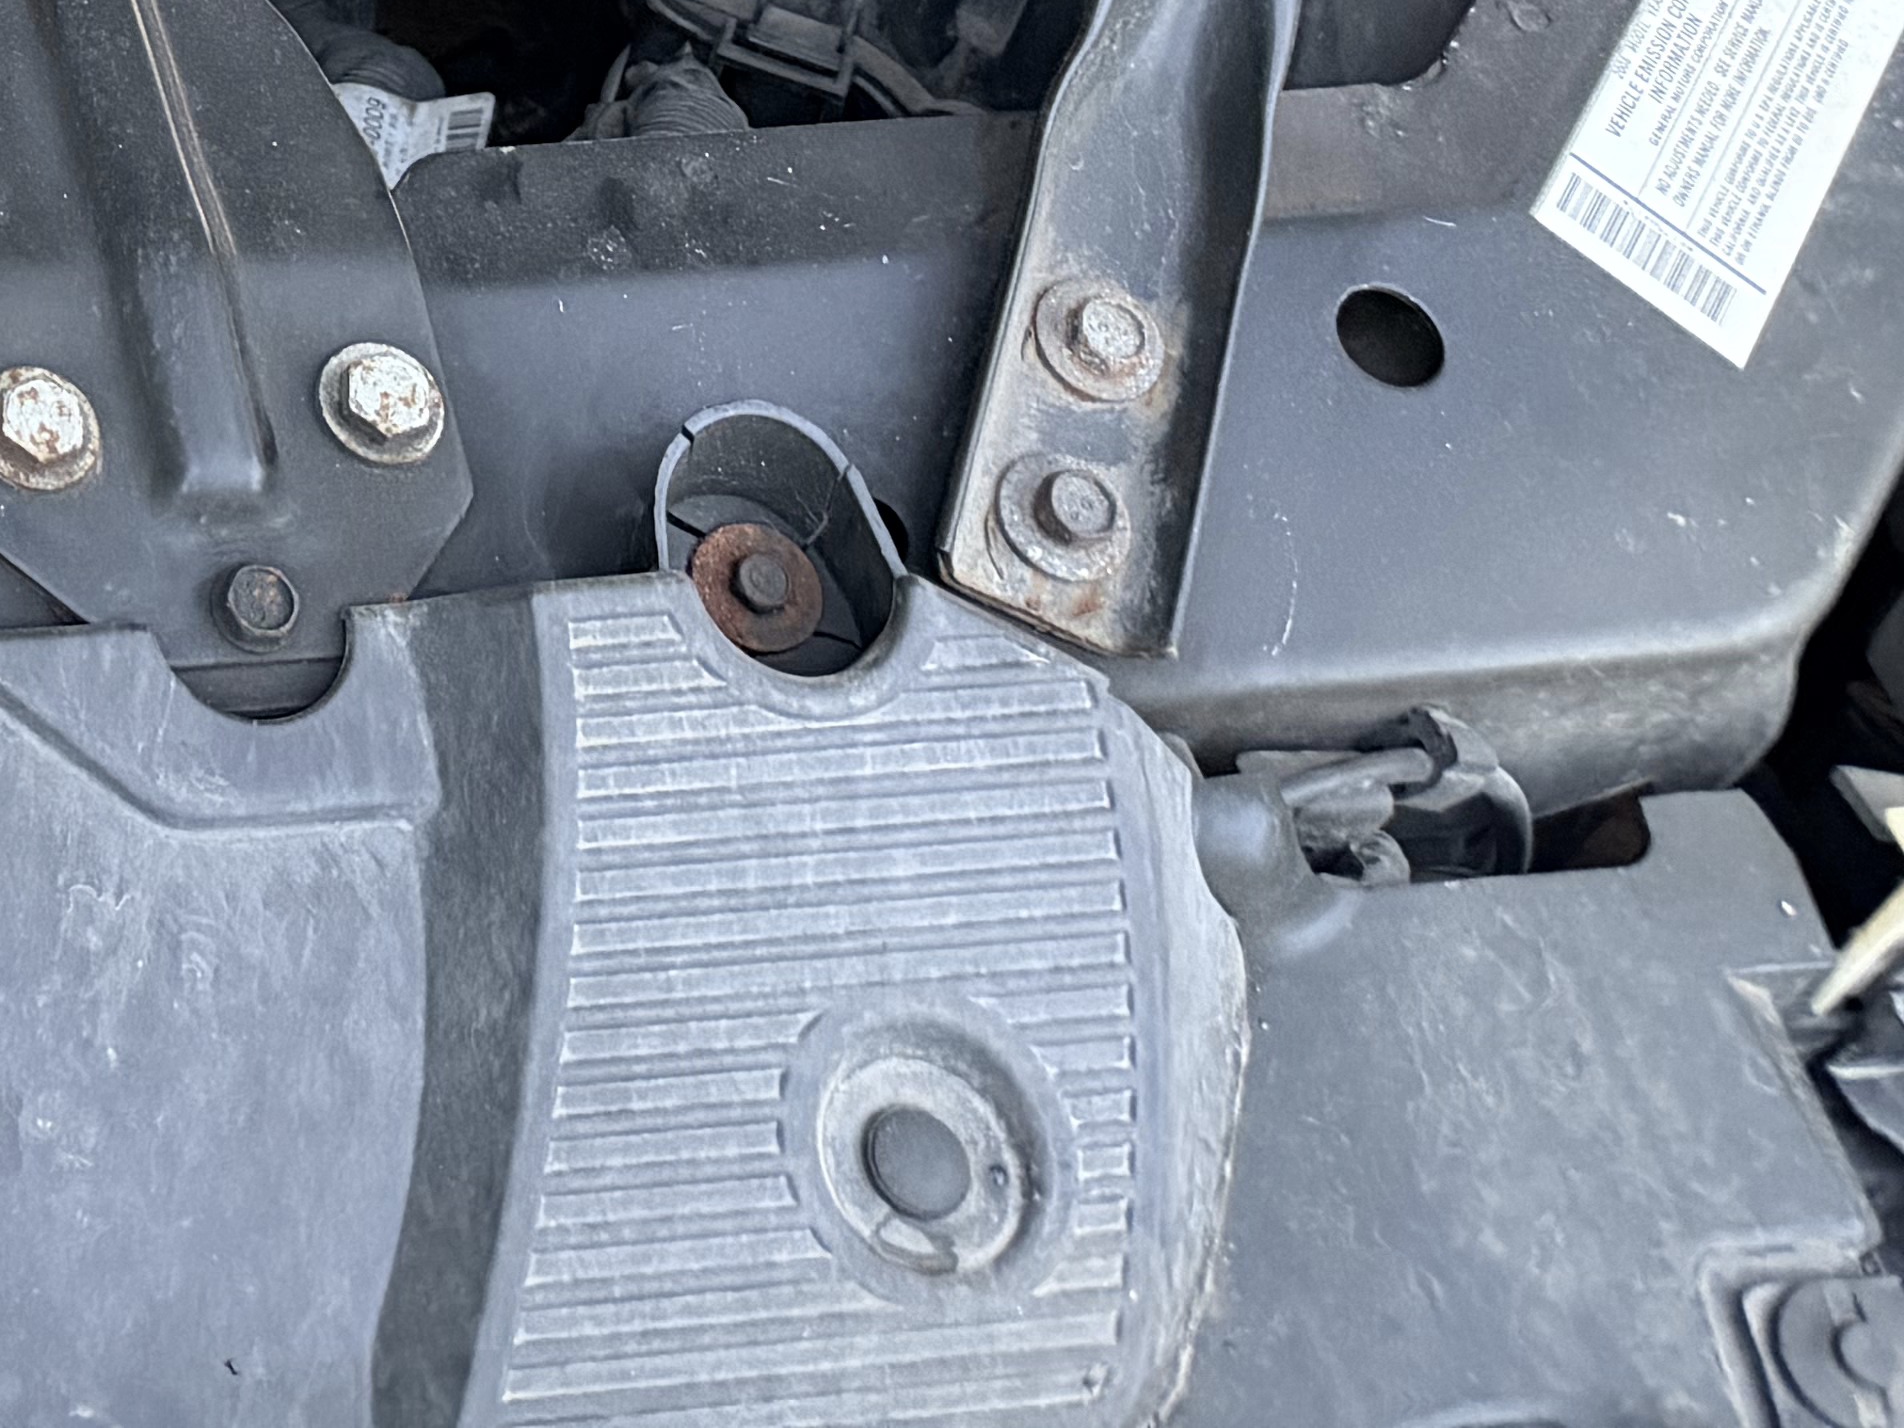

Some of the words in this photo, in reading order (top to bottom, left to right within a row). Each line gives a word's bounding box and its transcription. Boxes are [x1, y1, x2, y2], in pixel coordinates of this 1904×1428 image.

[1646, 11, 1703, 104] INFORMATION
[1721, 21, 1750, 60] SERVICE
[1604, 79, 1644, 139] VEHICLE
[1633, 16, 1677, 84] EMISSION
[1712, 56, 1732, 78] SEE
[1647, 102, 1676, 146] GENERAL
[1669, 62, 1696, 103] MOTORS
[1709, 108, 1729, 131] FOR
[1718, 84, 1741, 113] MORE
[1661, 114, 1703, 181] ADJUSTMENTS
[1691, 127, 1719, 169] MANUAL
[1654, 176, 1672, 196] NO
[1671, 165, 1701, 208] OWNERS
